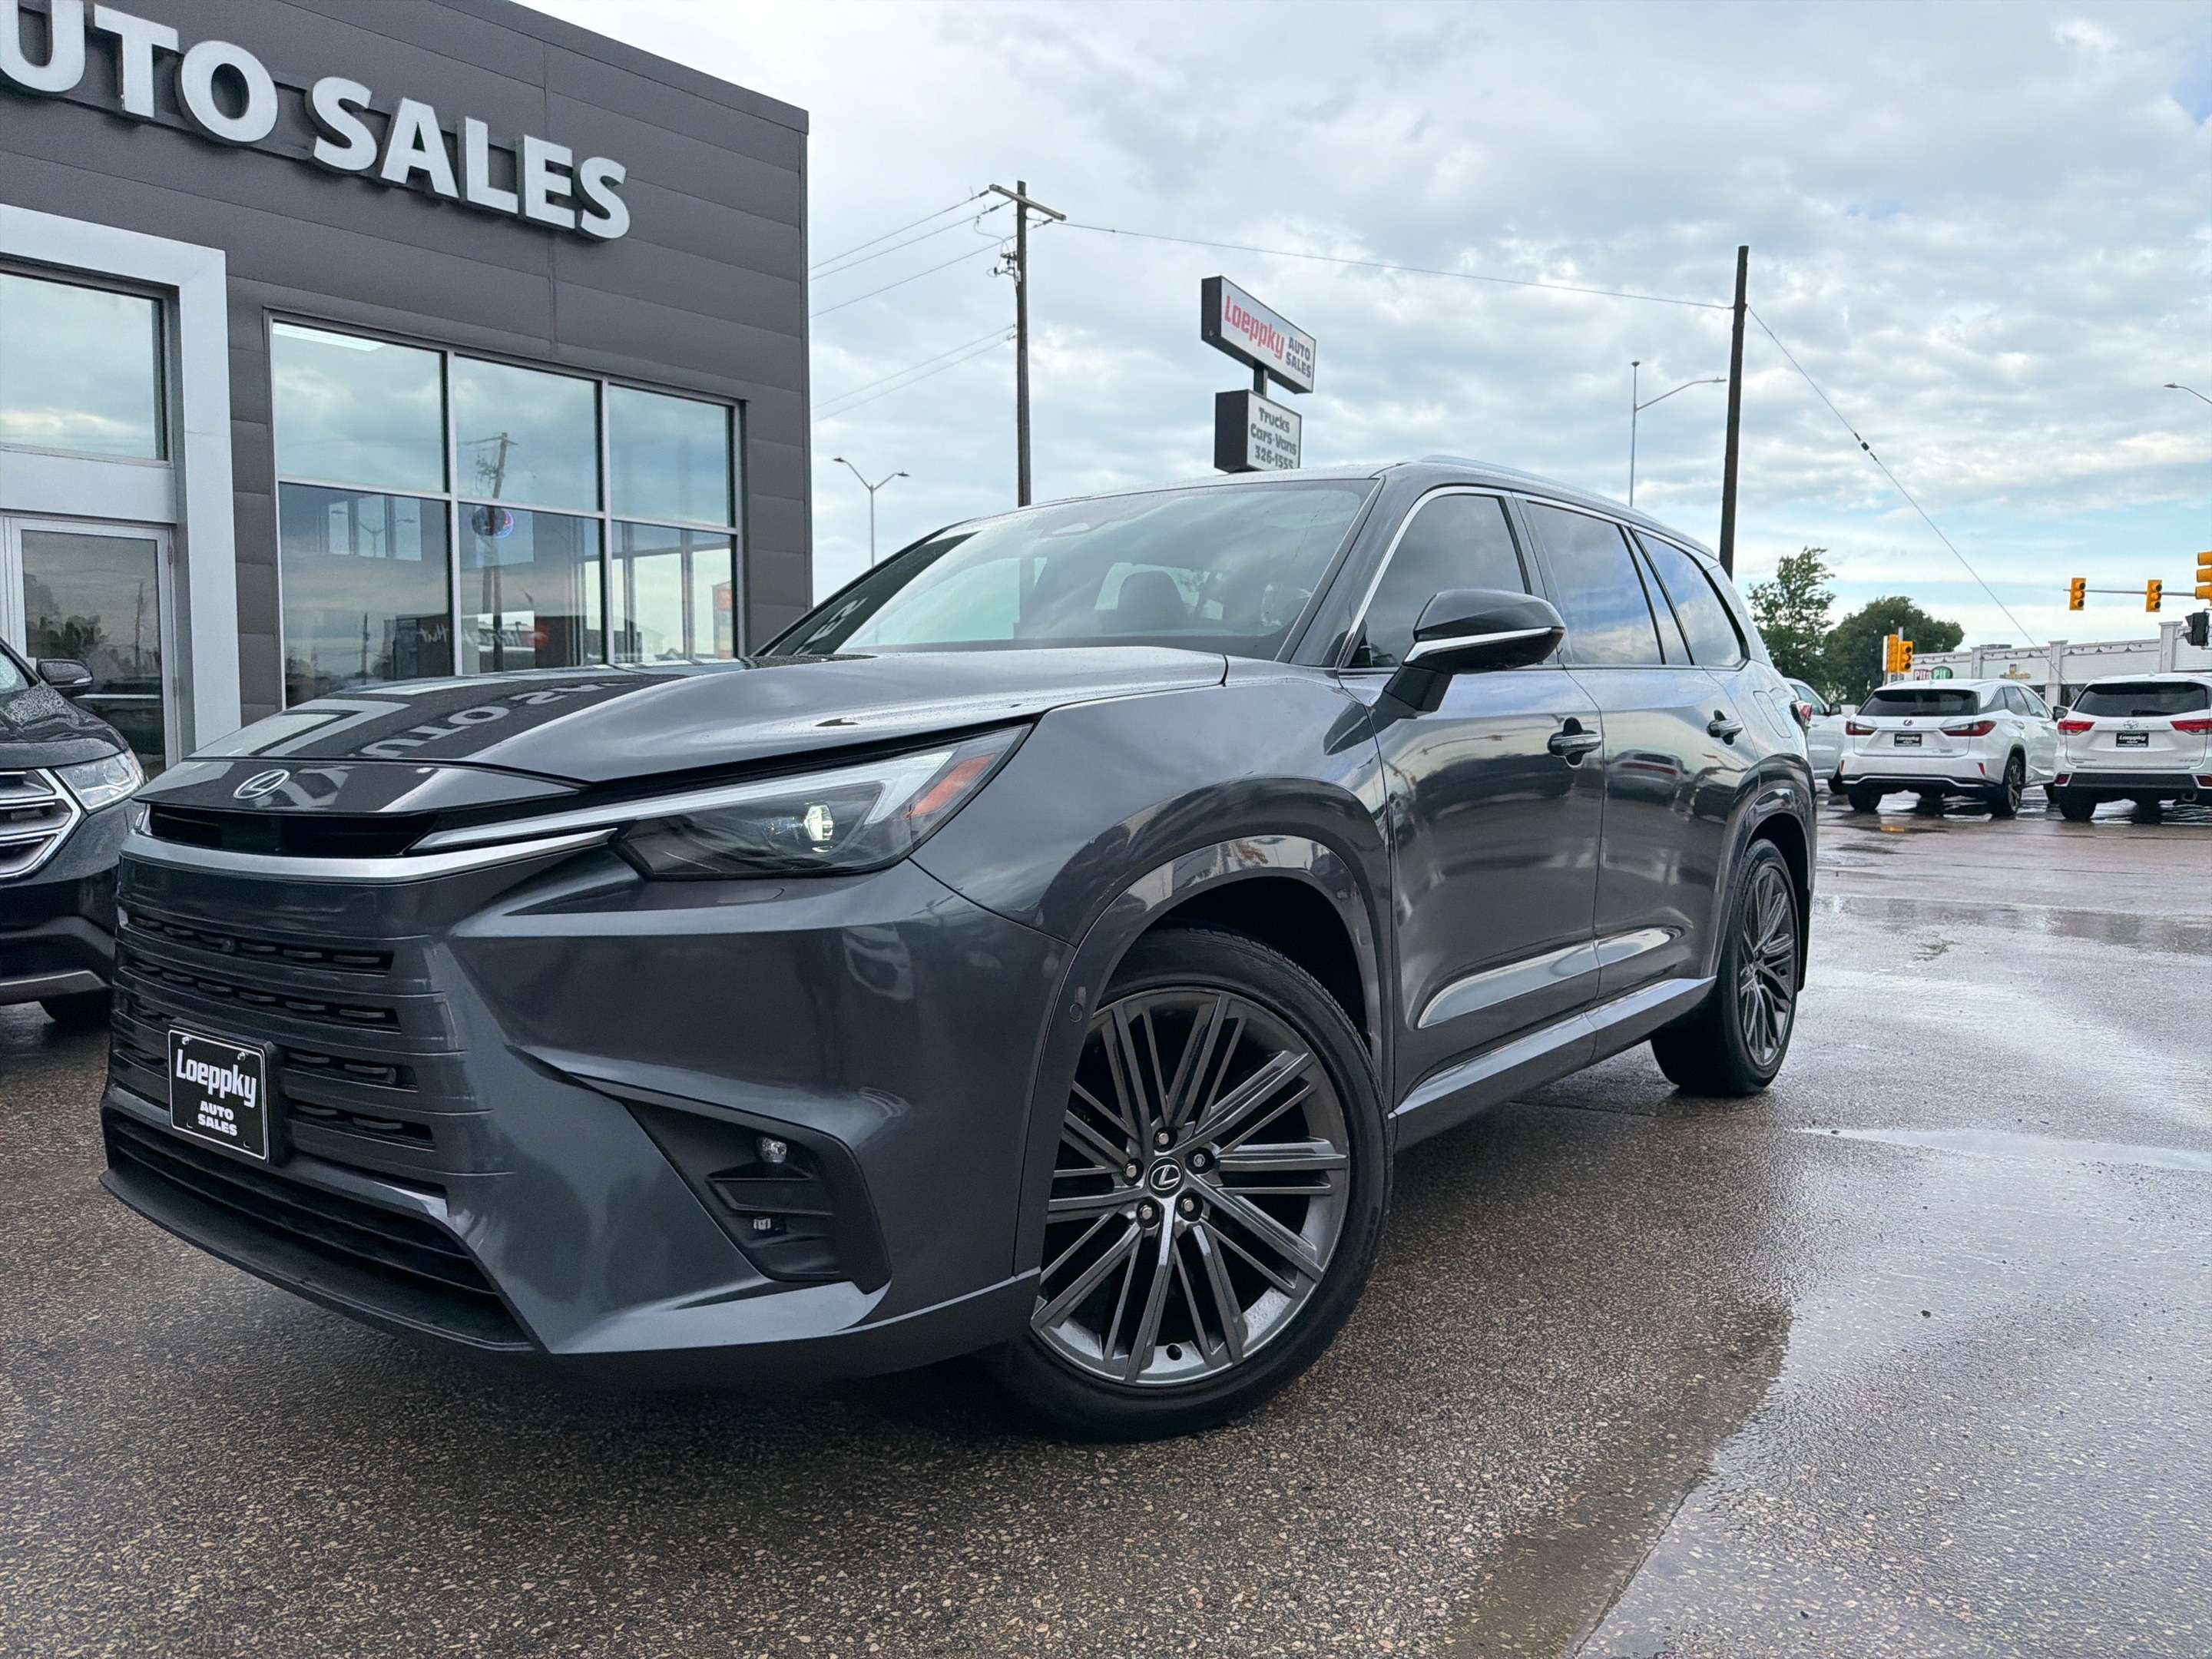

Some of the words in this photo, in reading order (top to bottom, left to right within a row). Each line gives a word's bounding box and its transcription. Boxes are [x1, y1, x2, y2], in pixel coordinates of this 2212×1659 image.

[312, 76, 631, 239] SALES
[1224, 294, 1285, 360] Loeppky
[1288, 336, 1310, 361] AUTO
[1286, 351, 1311, 378] SALES
[1259, 406, 1290, 434] Trucks
[176, 1048, 257, 1108] Loeppky
[200, 1100, 234, 1121] AUTO
[197, 1114, 238, 1137] SALES
